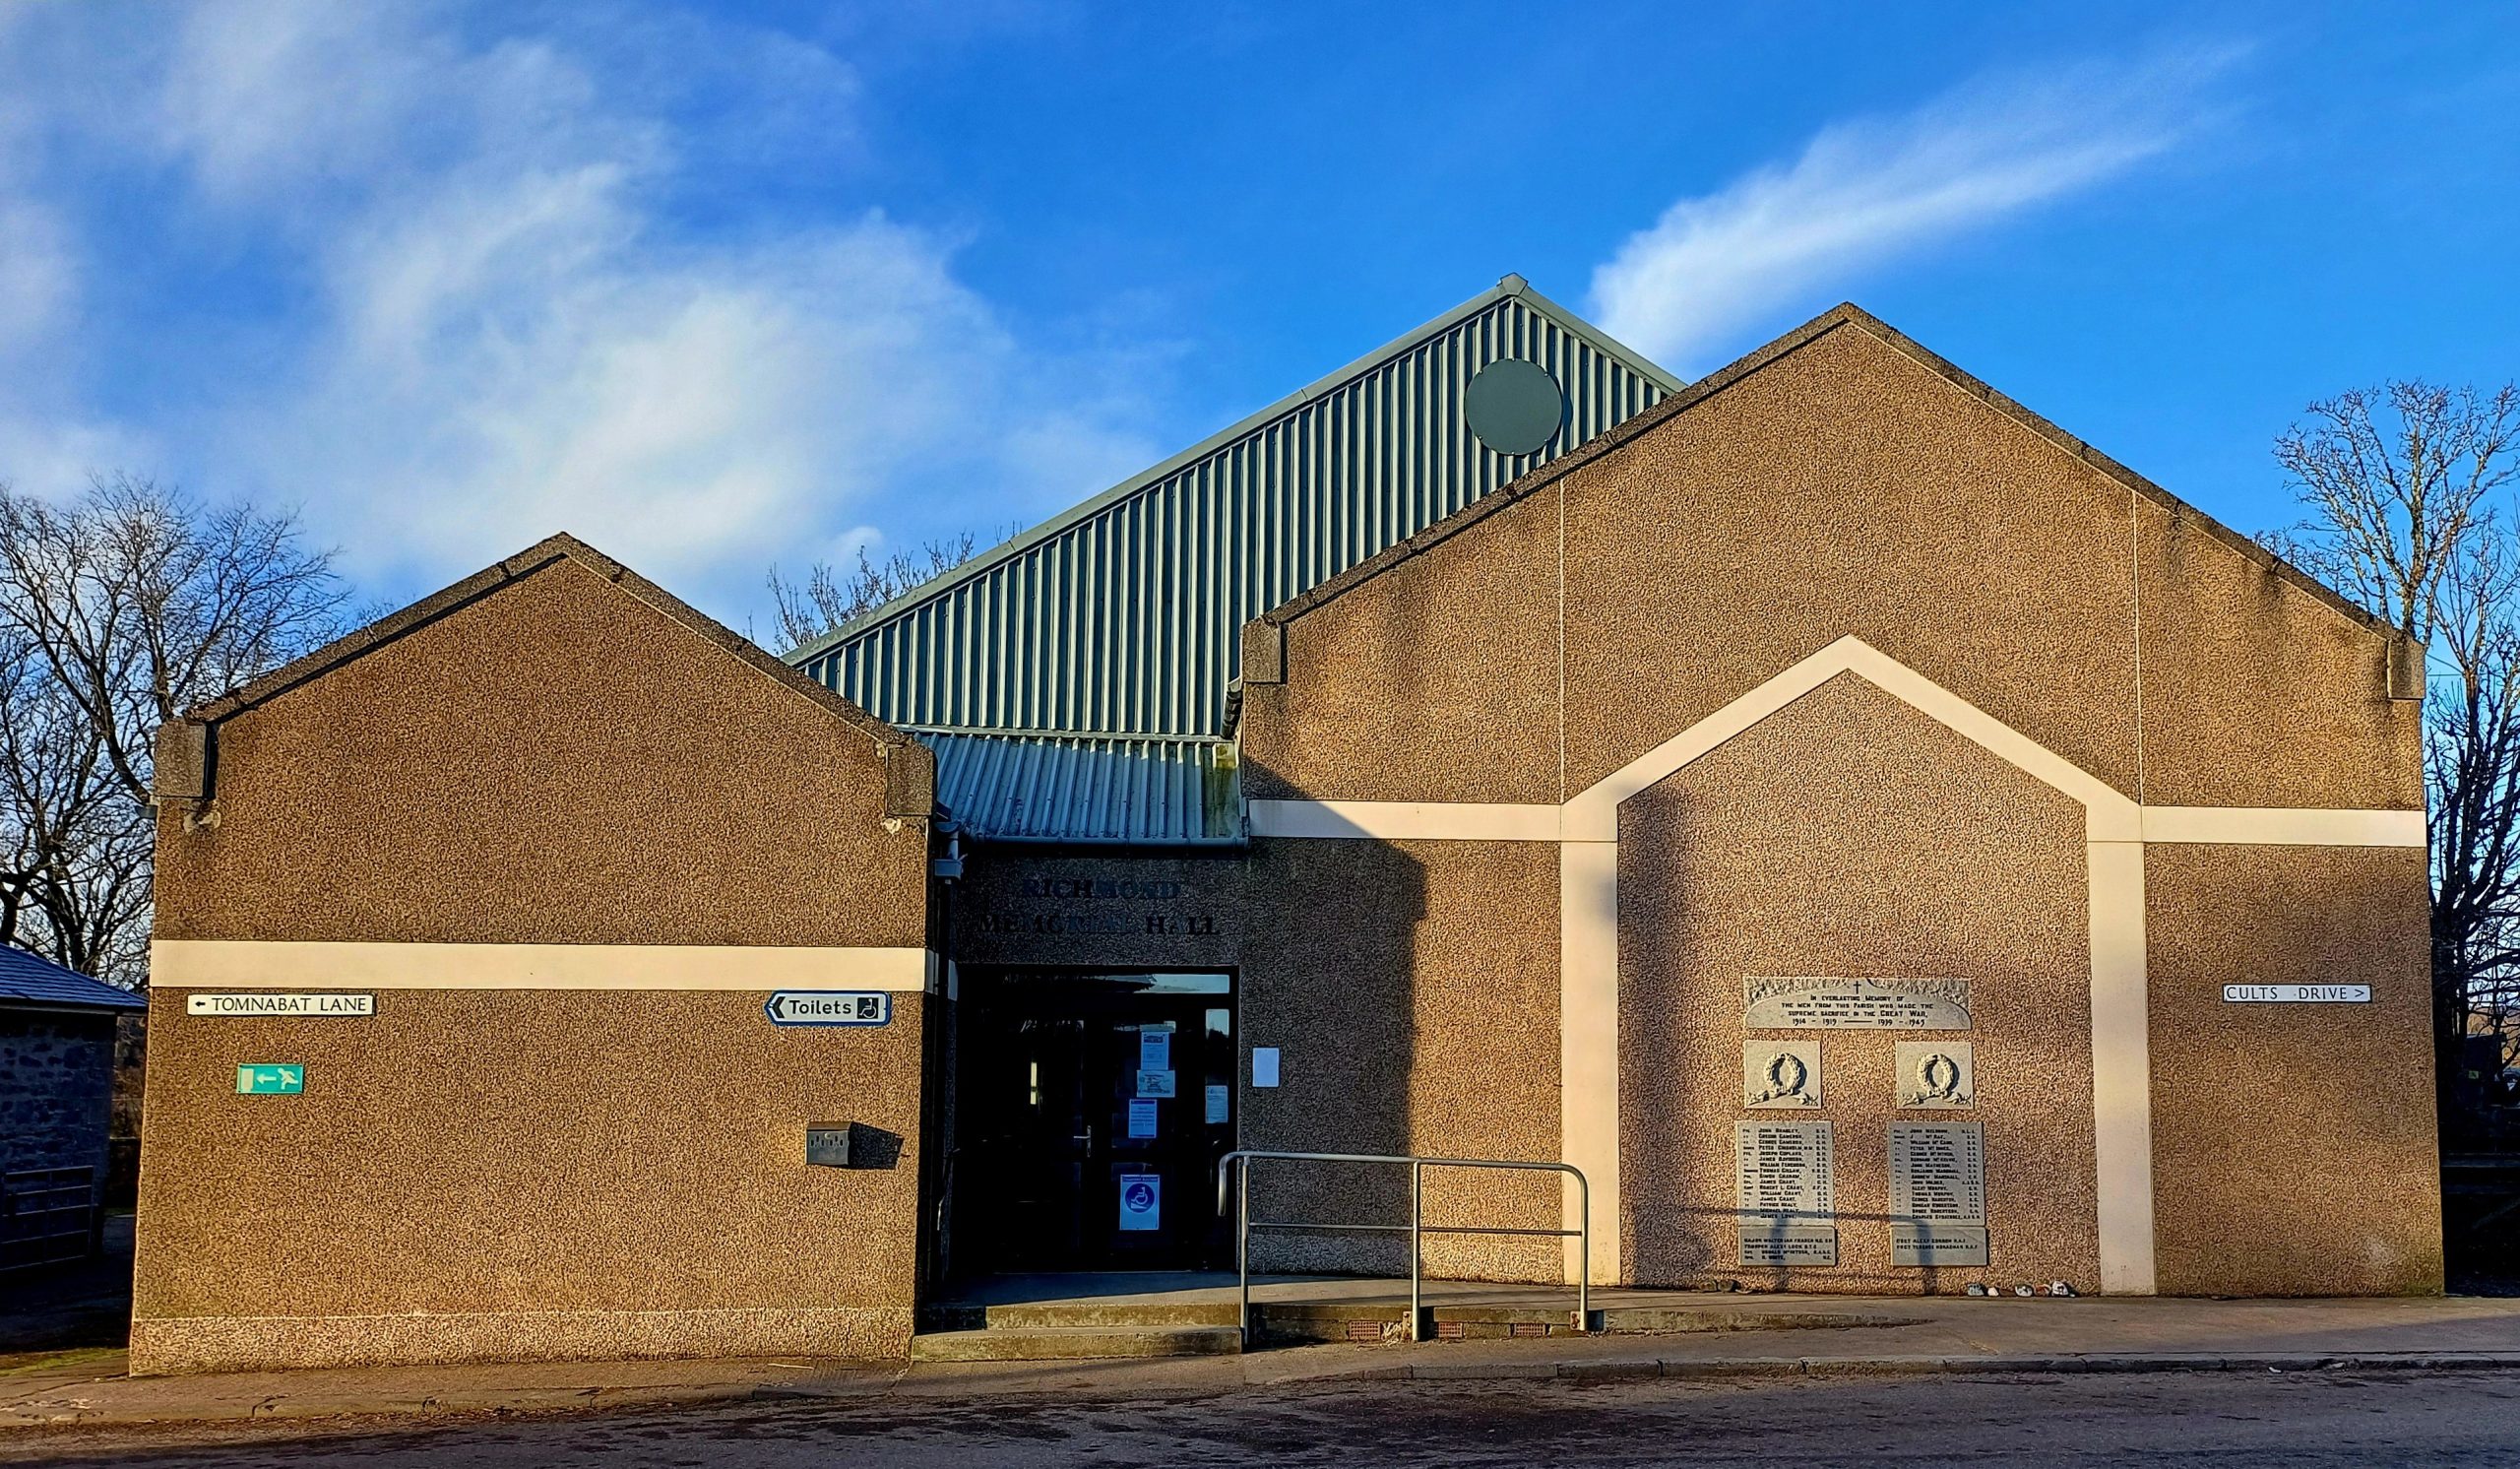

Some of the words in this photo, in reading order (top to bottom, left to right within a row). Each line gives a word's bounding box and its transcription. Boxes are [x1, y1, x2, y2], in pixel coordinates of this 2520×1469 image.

[2227, 987, 2278, 1000] CULTS
[2299, 987, 2347, 1000] DRIVE
[212, 997, 311, 1011] TOMNABAT
[320, 997, 366, 1011] LANE
[788, 999, 851, 1014] Toilets
